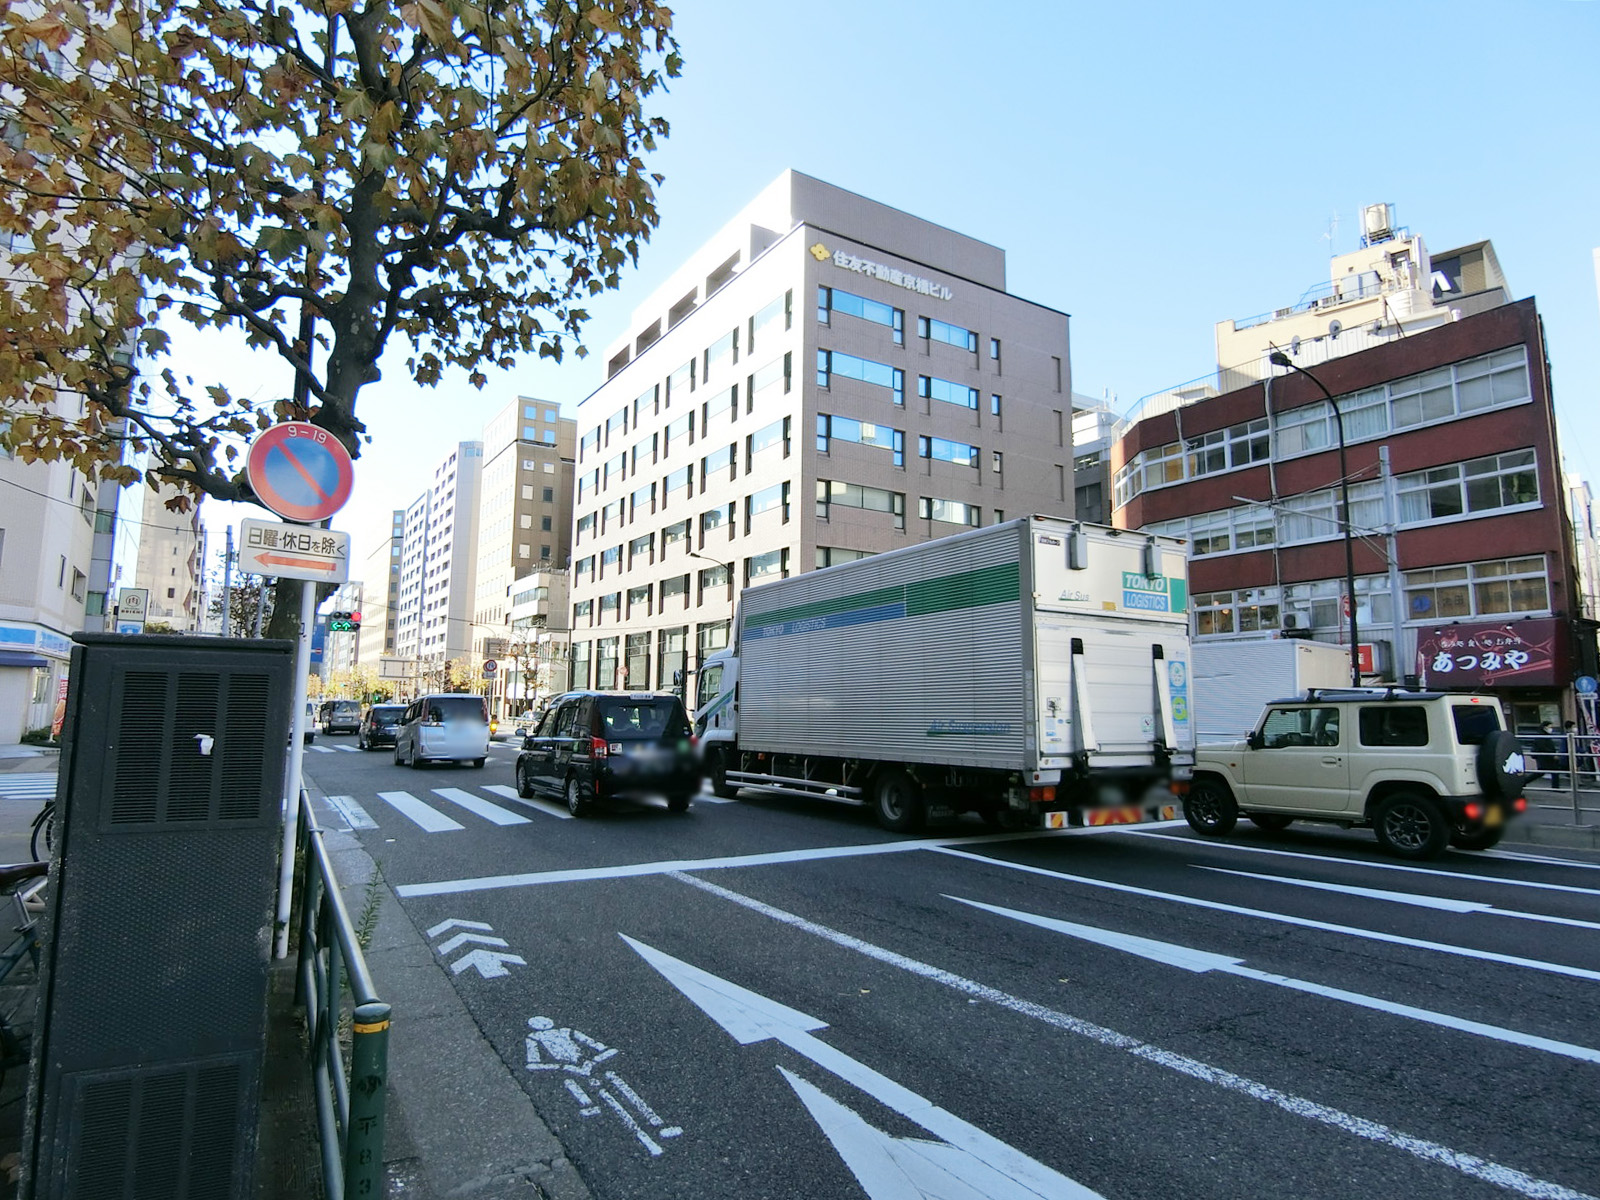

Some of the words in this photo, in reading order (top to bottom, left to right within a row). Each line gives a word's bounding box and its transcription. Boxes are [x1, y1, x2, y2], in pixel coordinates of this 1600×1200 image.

[287, 425, 327, 444] 9-19
[1126, 594, 1166, 610] LOGISTICS
[762, 624, 784, 637] TOKYO
[791, 617, 827, 633] LOGISTICS
[1432, 650, 1529, 672] あつみや
